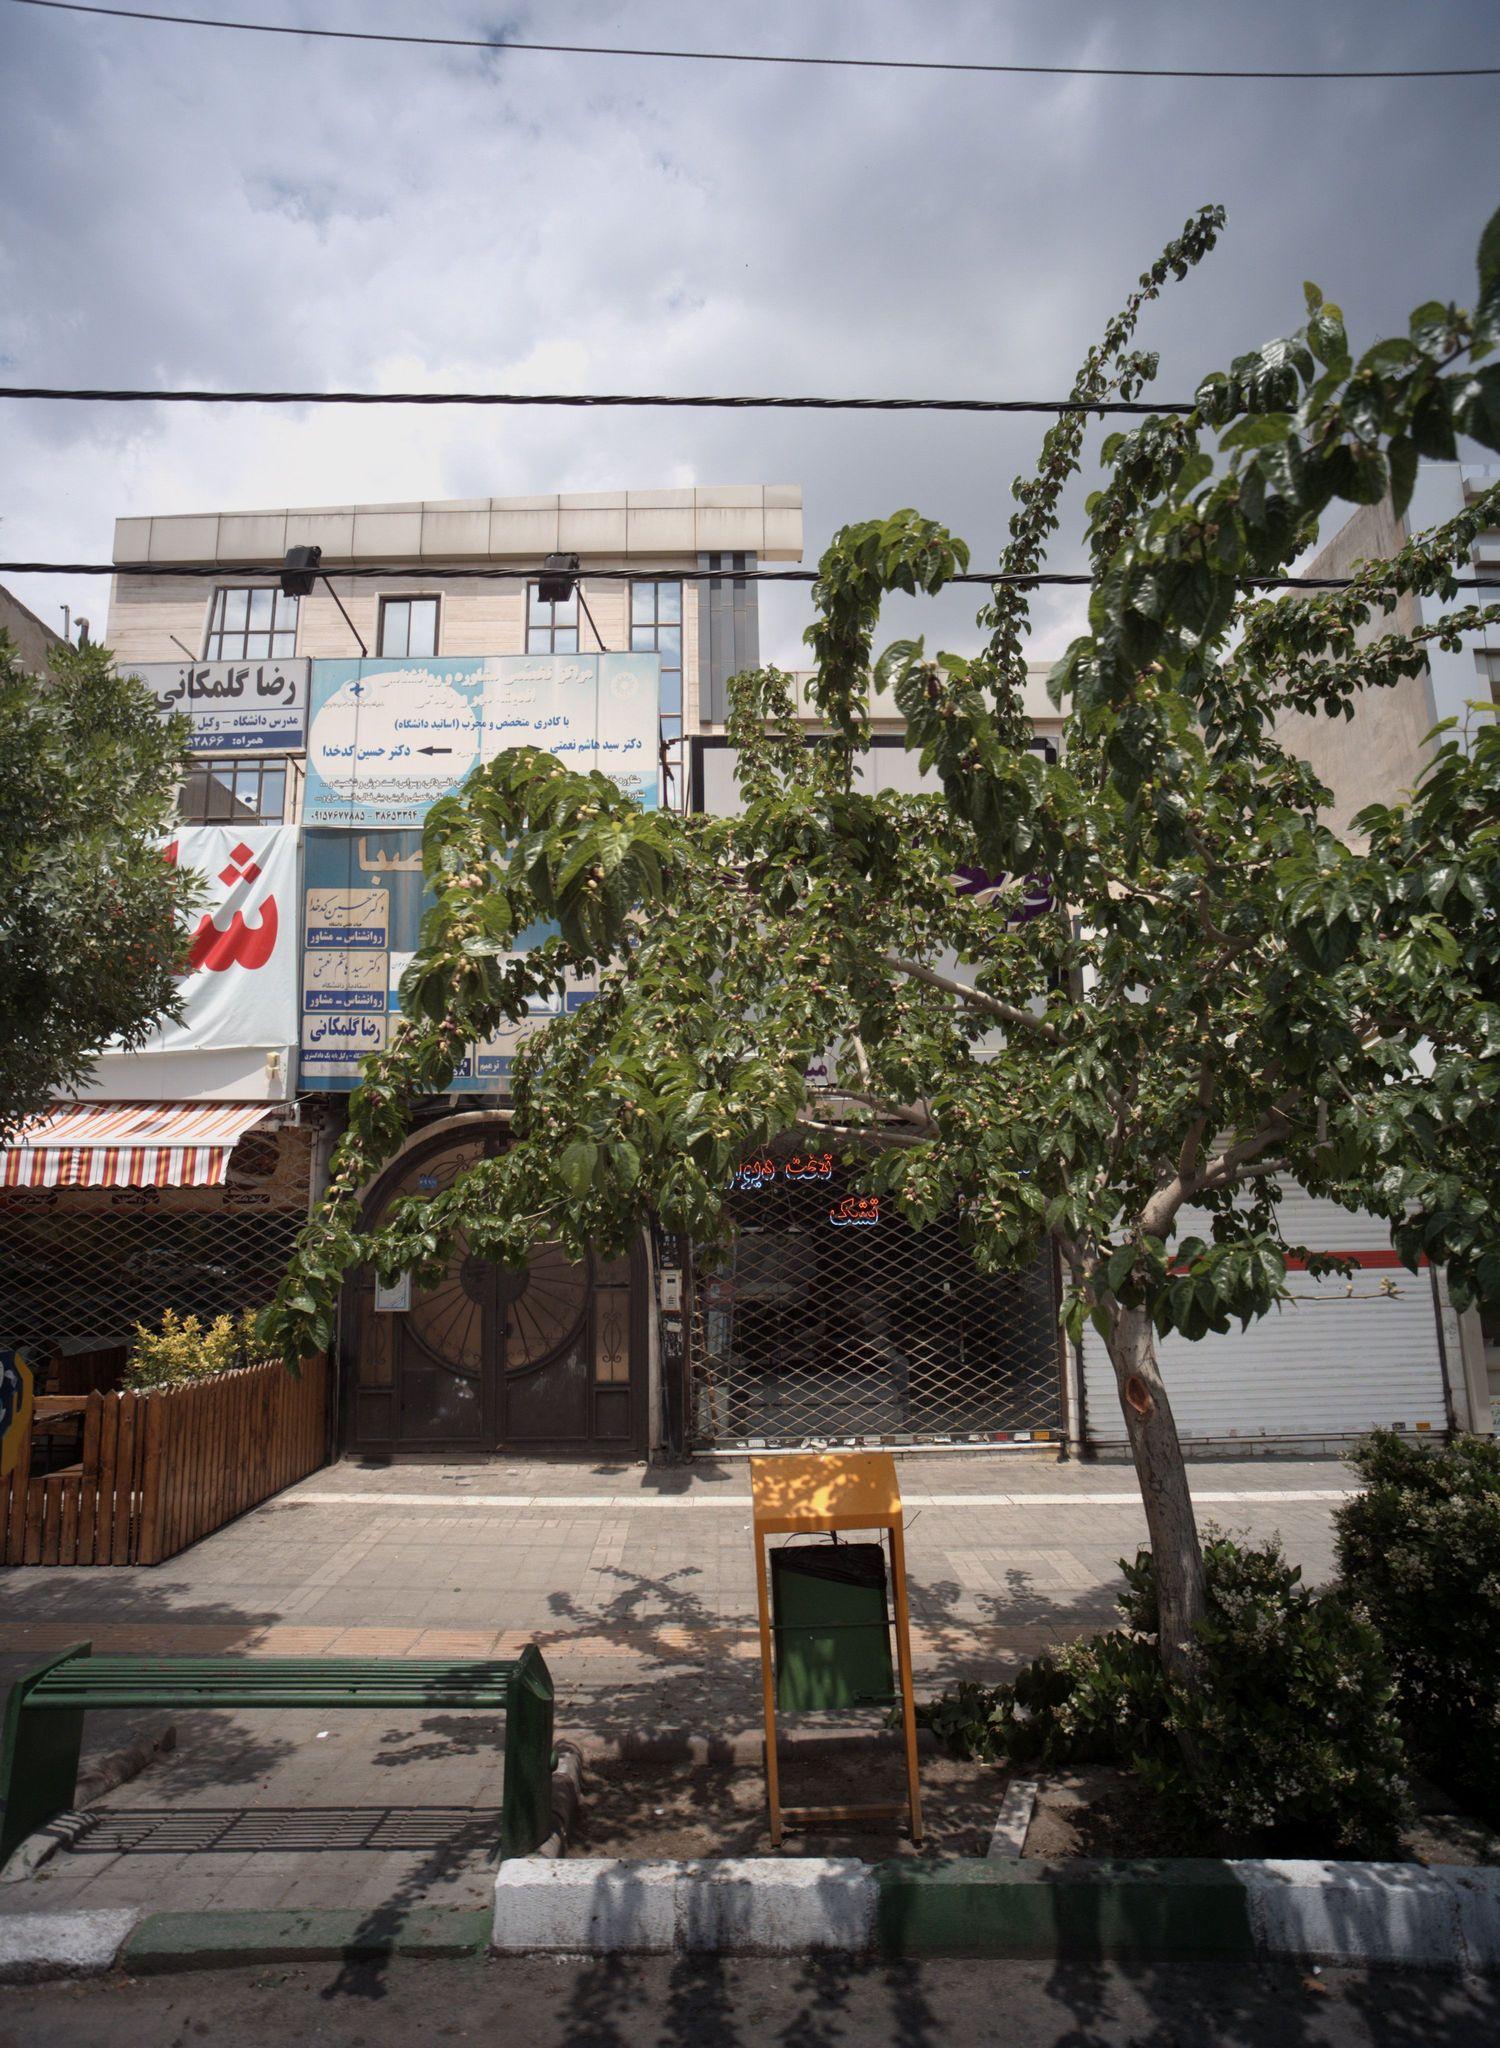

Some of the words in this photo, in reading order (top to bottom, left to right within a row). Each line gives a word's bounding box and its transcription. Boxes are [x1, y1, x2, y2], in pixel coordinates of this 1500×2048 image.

[154, 666, 250, 711] گلمکانی
[256, 665, 296, 706] رضا
[197, 716, 220, 731] وکیل
[232, 714, 267, 727] دانشگاه
[268, 715, 299, 729] مدرس
[394, 718, 429, 731] دانشگاه)
[489, 721, 494, 731] و
[534, 716, 562, 730] کادری
[563, 716, 570, 728] با
[231, 736, 264, 748] همراه:
[549, 739, 577, 755] نعمتی
[578, 738, 601, 754] هاشم
[602, 739, 619, 753] سید
[621, 738, 643, 754] دکتر
[322, 743, 356, 758] کدخدا
[357, 744, 386, 761] حسین
[387, 744, 411, 761] دکتر
[309, 895, 338, 913] کدخدا
[324, 897, 373, 920] حسین
[363, 892, 386, 921] دکتر
[310, 930, 334, 944] مشاور
[344, 931, 383, 944] روانشناس
[313, 953, 333, 978] نعمتی
[334, 952, 349, 981] هاشم
[351, 966, 364, 978] سید
[363, 953, 385, 978] دکتر
[309, 994, 334, 1008] مشاور
[344, 994, 383, 1008] روانشناس
[310, 1016, 360, 1042] گلمکانی
[361, 1016, 381, 1044] رضا
[829, 1197, 879, 1226] تشک
